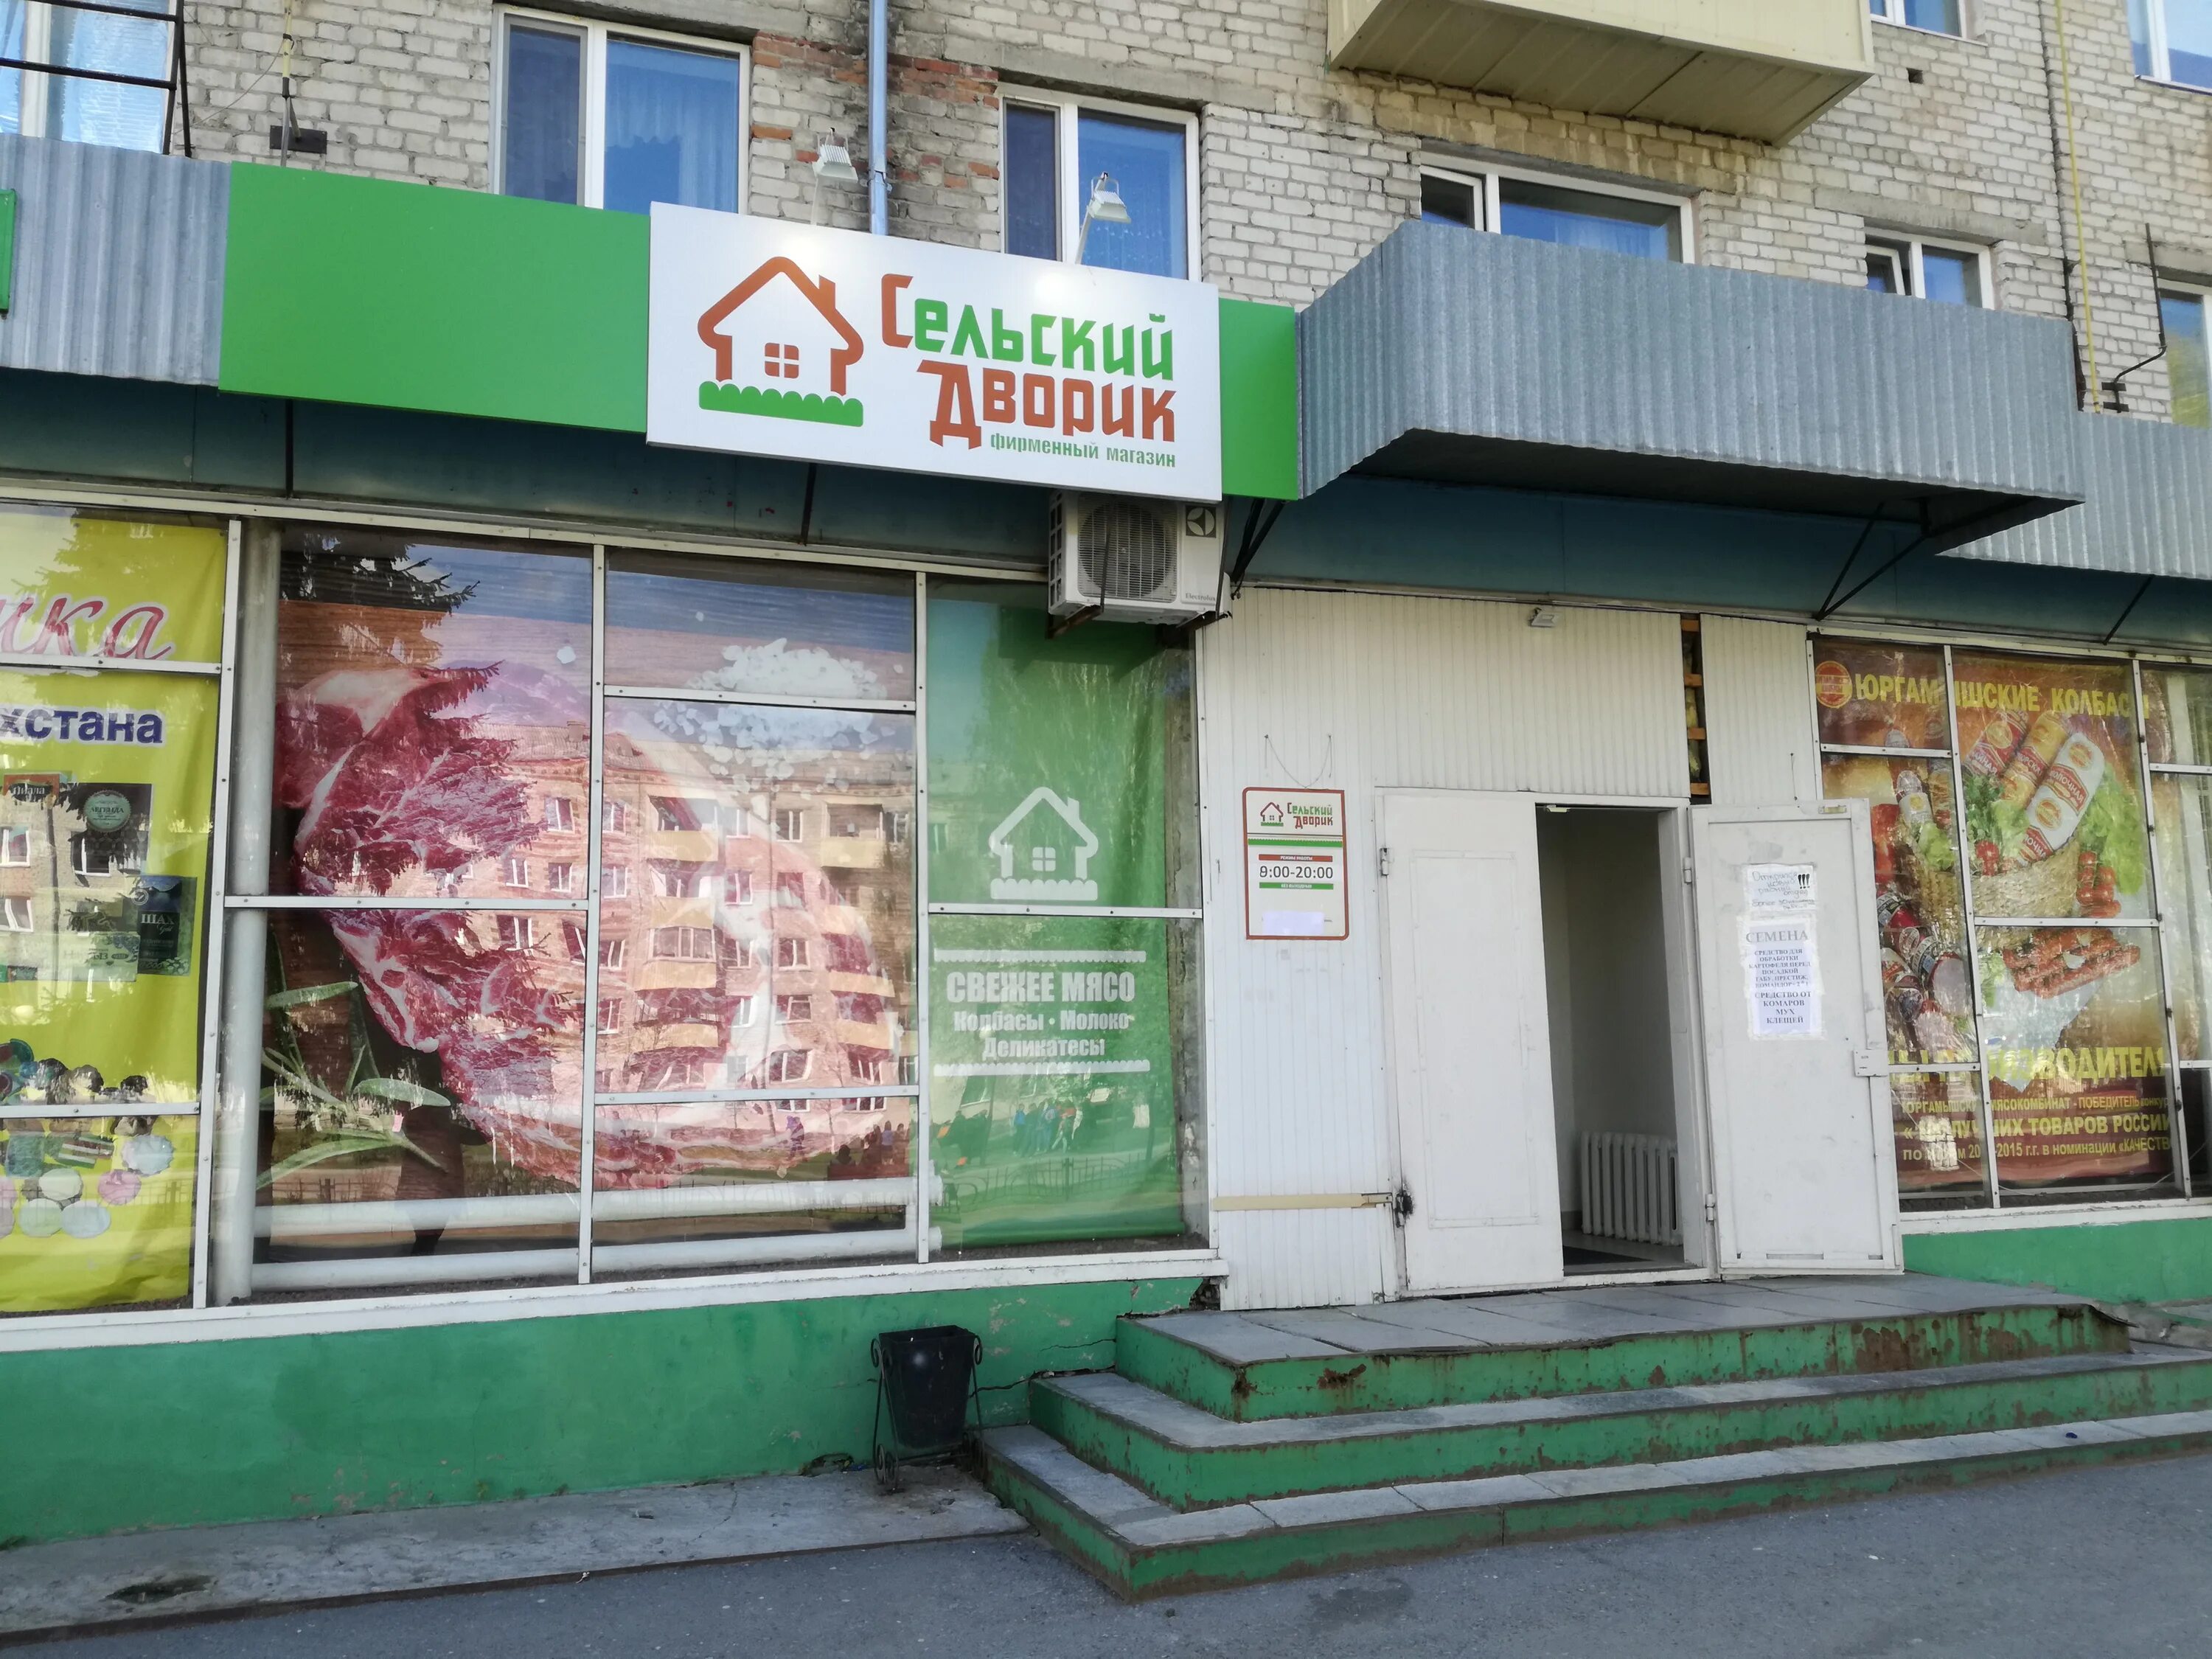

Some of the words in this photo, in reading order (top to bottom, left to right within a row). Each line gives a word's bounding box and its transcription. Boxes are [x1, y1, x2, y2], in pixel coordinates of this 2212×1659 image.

[881, 274, 1173, 380] Сельский
[917, 359, 1177, 450] Дворик
[990, 433, 1099, 459] фирменный
[1107, 446, 1175, 467] магазин
[1186, 593, 1216, 602] Electrolux
[1855, 672, 2041, 712] ЮРГАМШСКИЕ
[1287, 801, 1333, 816] Сельский
[1293, 815, 1334, 830] Дворик
[1745, 930, 1809, 943] СЕМЕНА
[947, 971, 1054, 1003] СВЕЖЕЕ
[1062, 971, 1135, 1003] МЯСО
[954, 1010, 1045, 1032] Колбасы
[1060, 1009, 1130, 1030] Молоко
[982, 1037, 1105, 1061] Деликатесы
[2079, 1096, 2139, 1110] ПОБЕДИТЕЛЬ
[2028, 1115, 2109, 1136] ТОВАРОВ
[2052, 1142, 2116, 1157] номинации
